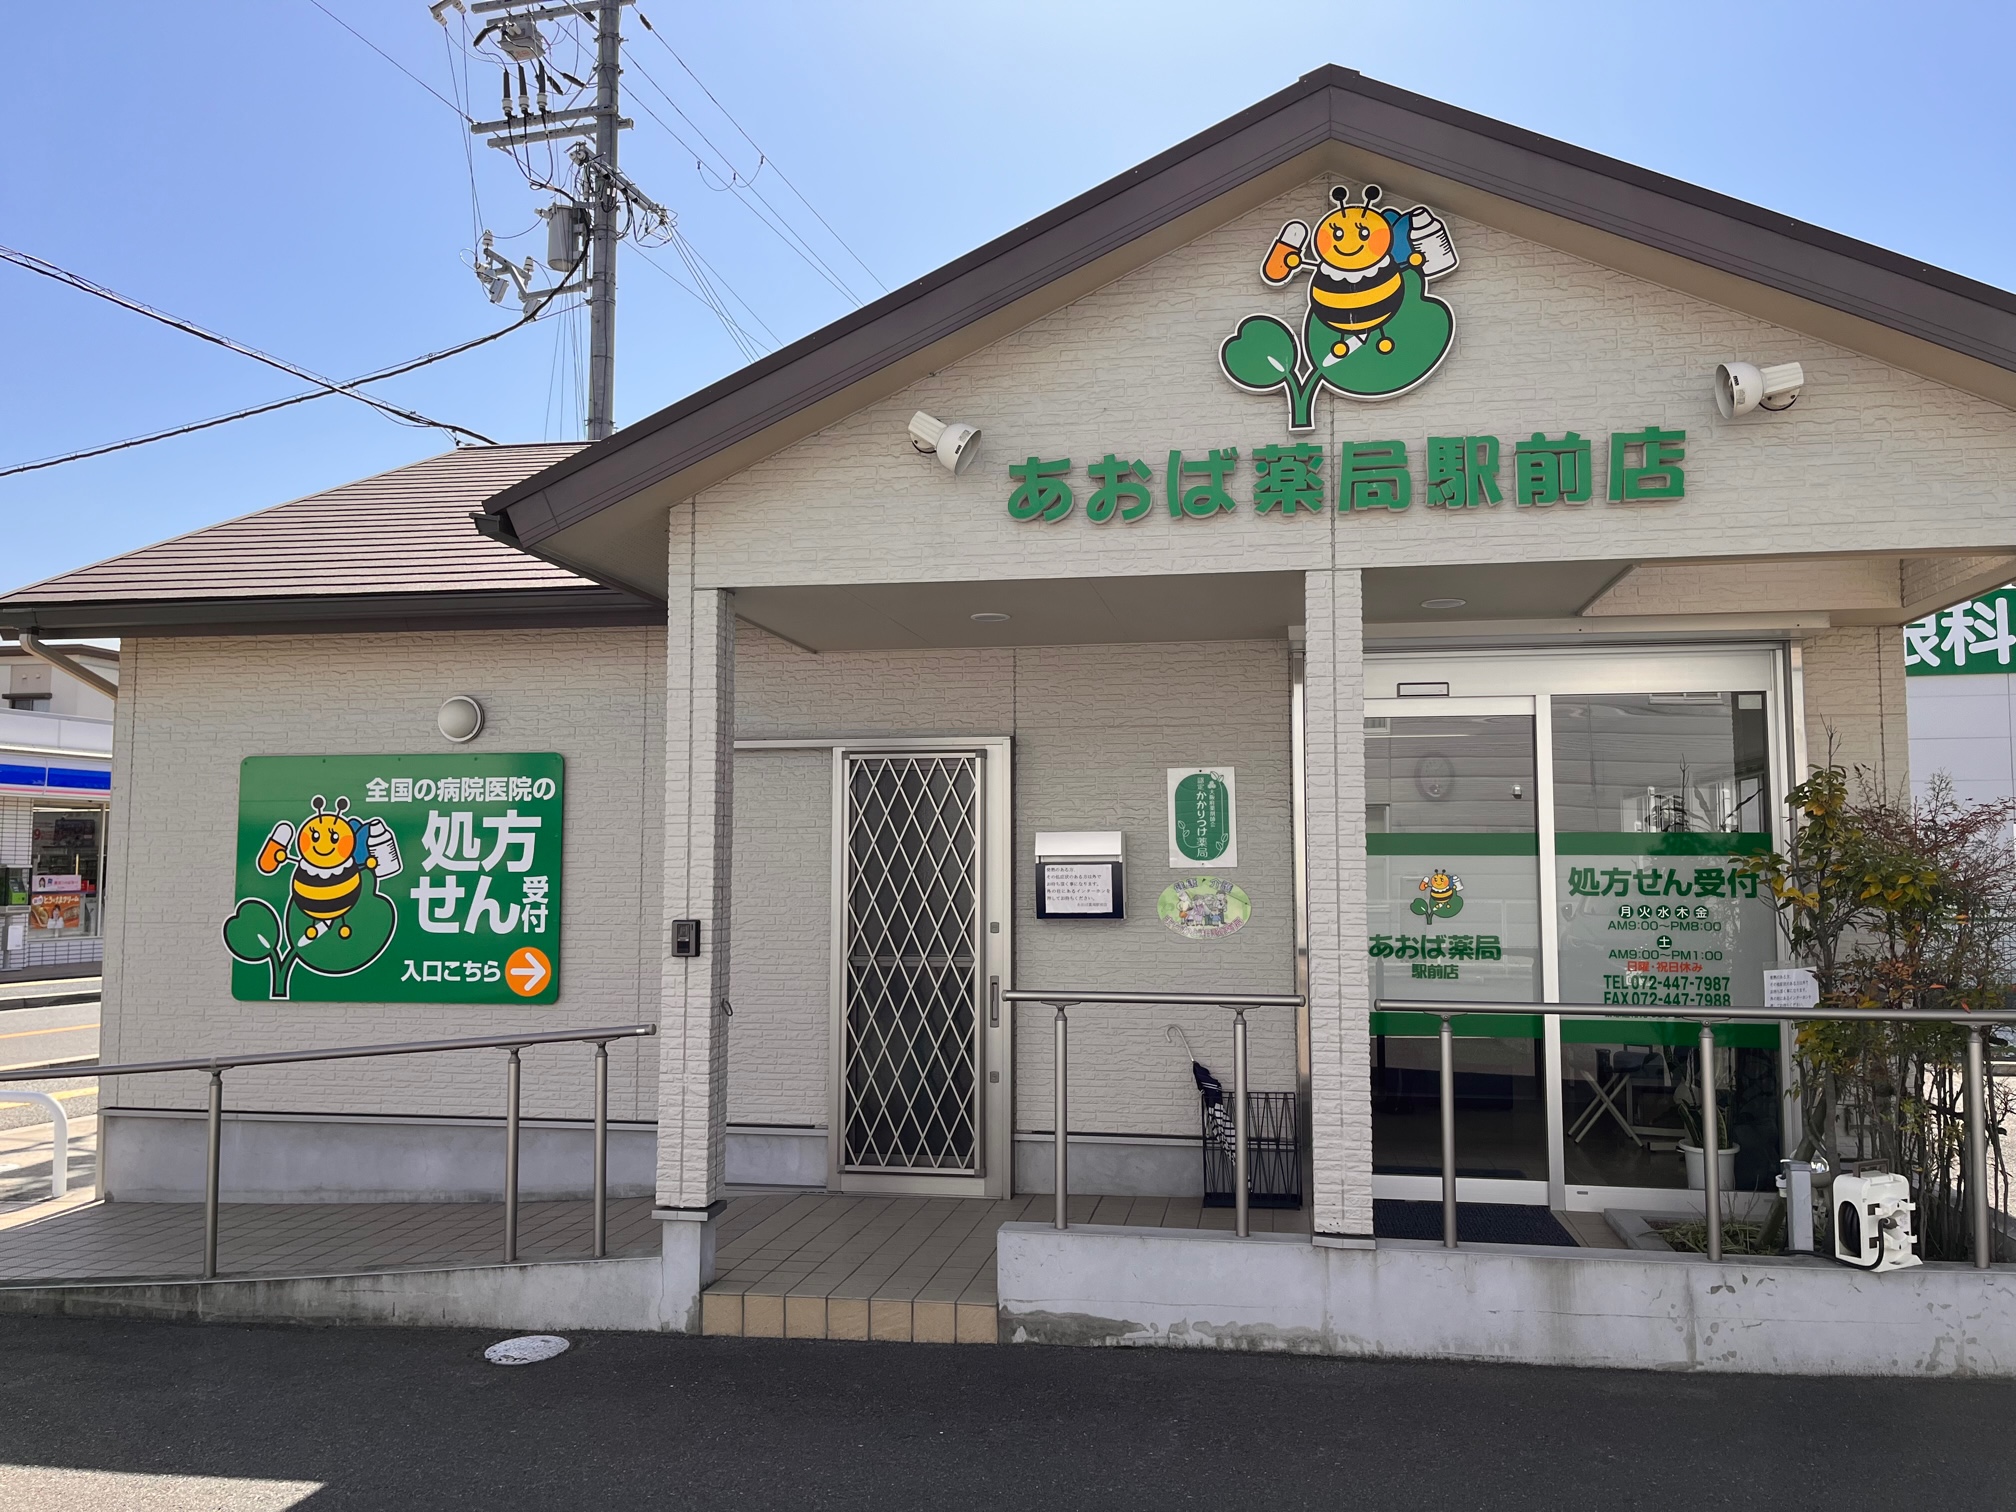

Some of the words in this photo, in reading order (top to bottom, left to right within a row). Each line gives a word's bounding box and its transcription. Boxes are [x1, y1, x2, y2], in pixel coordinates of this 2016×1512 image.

[1006, 425, 1687, 525] あおば薬局駅前店
[365, 777, 556, 803] 全国の病院医院の
[421, 809, 542, 873] 処方
[1567, 866, 1759, 899] 処方せん受付
[410, 875, 522, 934] せん
[521, 875, 549, 934] 受付
[1368, 933, 1502, 961] あおば薬局
[400, 959, 501, 983] 入口こちら
[1411, 963, 1459, 980] 駅前店
[1603, 974, 1629, 990] TEL
[1631, 975, 1731, 992] 072-447-7987
[1603, 991, 1629, 1005] FAX
[1631, 991, 1732, 1007] 072-447-7988
